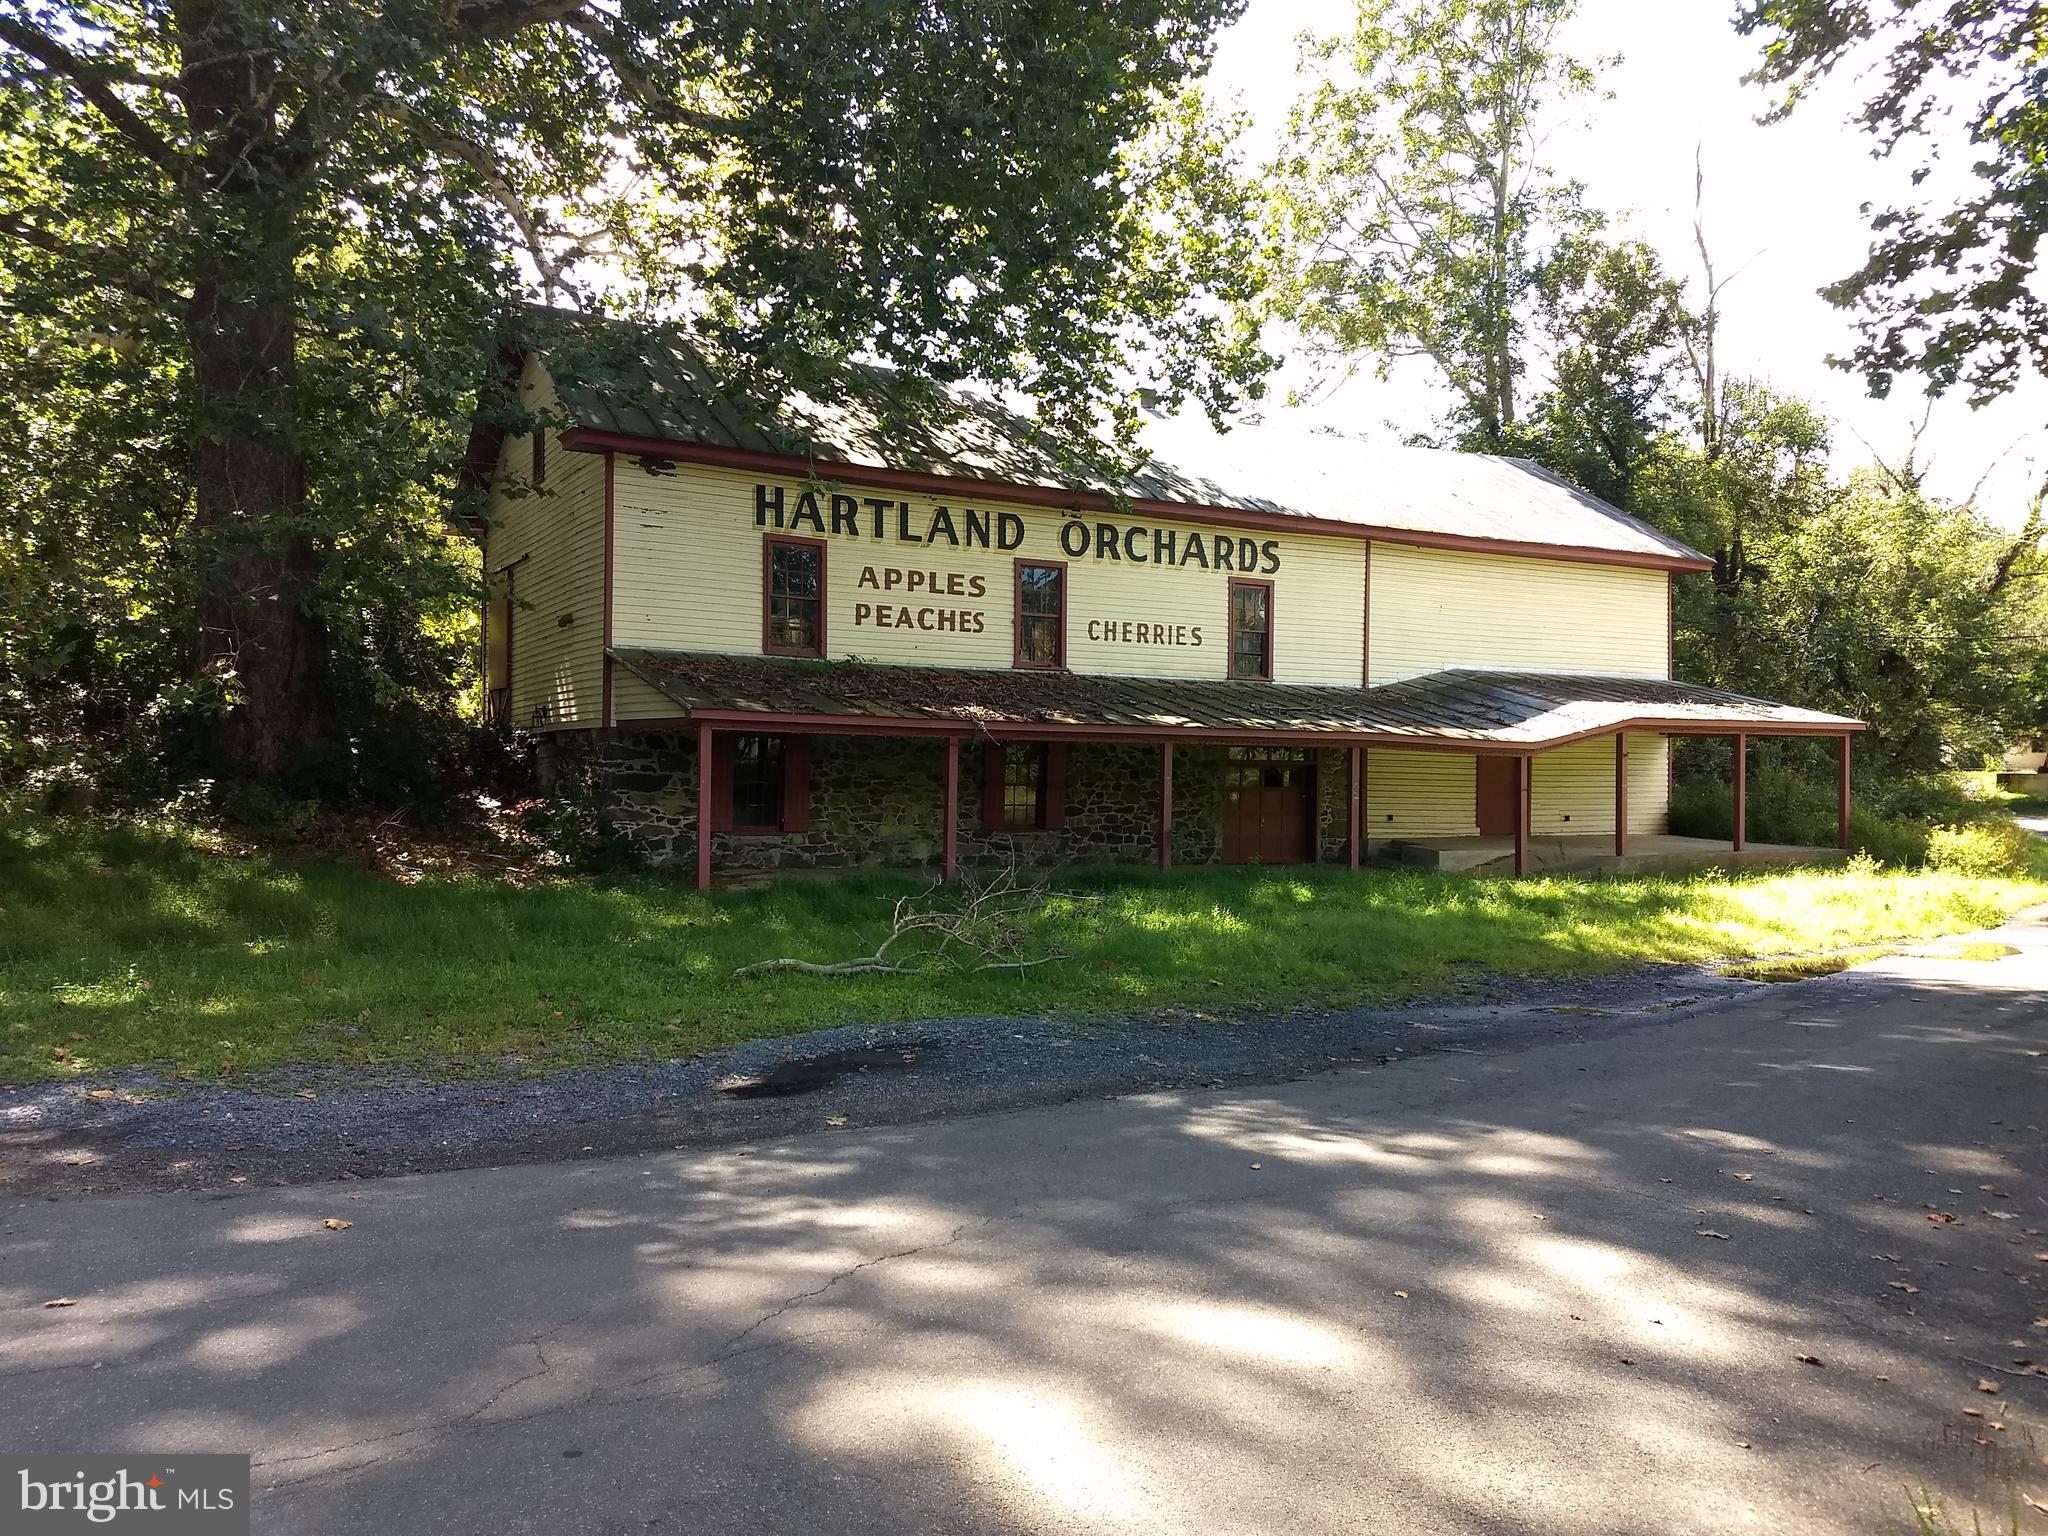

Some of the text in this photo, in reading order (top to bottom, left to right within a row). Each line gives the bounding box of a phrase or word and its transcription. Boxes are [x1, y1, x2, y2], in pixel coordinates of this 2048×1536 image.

[755, 484, 1281, 574] HARTLAND ORCHARDS
[857, 566, 986, 598] APPLES
[855, 603, 985, 633] PEACHES
[1087, 620, 1203, 646] CHERRIES
